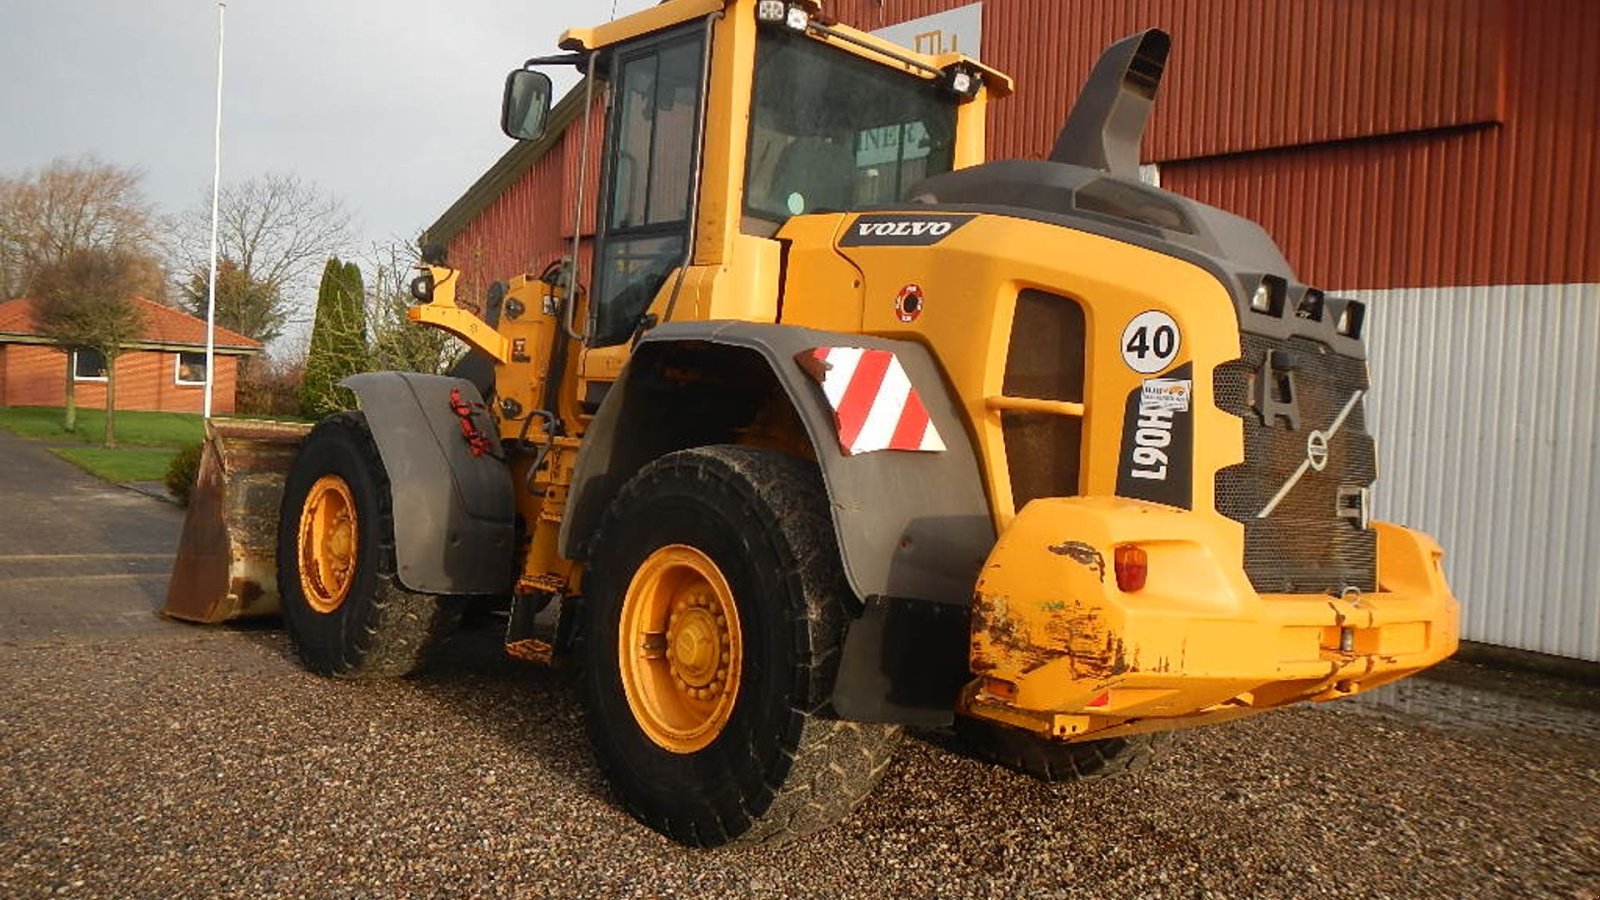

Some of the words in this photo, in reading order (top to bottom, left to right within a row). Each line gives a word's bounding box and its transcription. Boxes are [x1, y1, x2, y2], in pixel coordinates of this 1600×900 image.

[858, 222, 951, 236] VOLVO
[1126, 325, 1175, 359] 40
[1131, 408, 1174, 481] L90H
